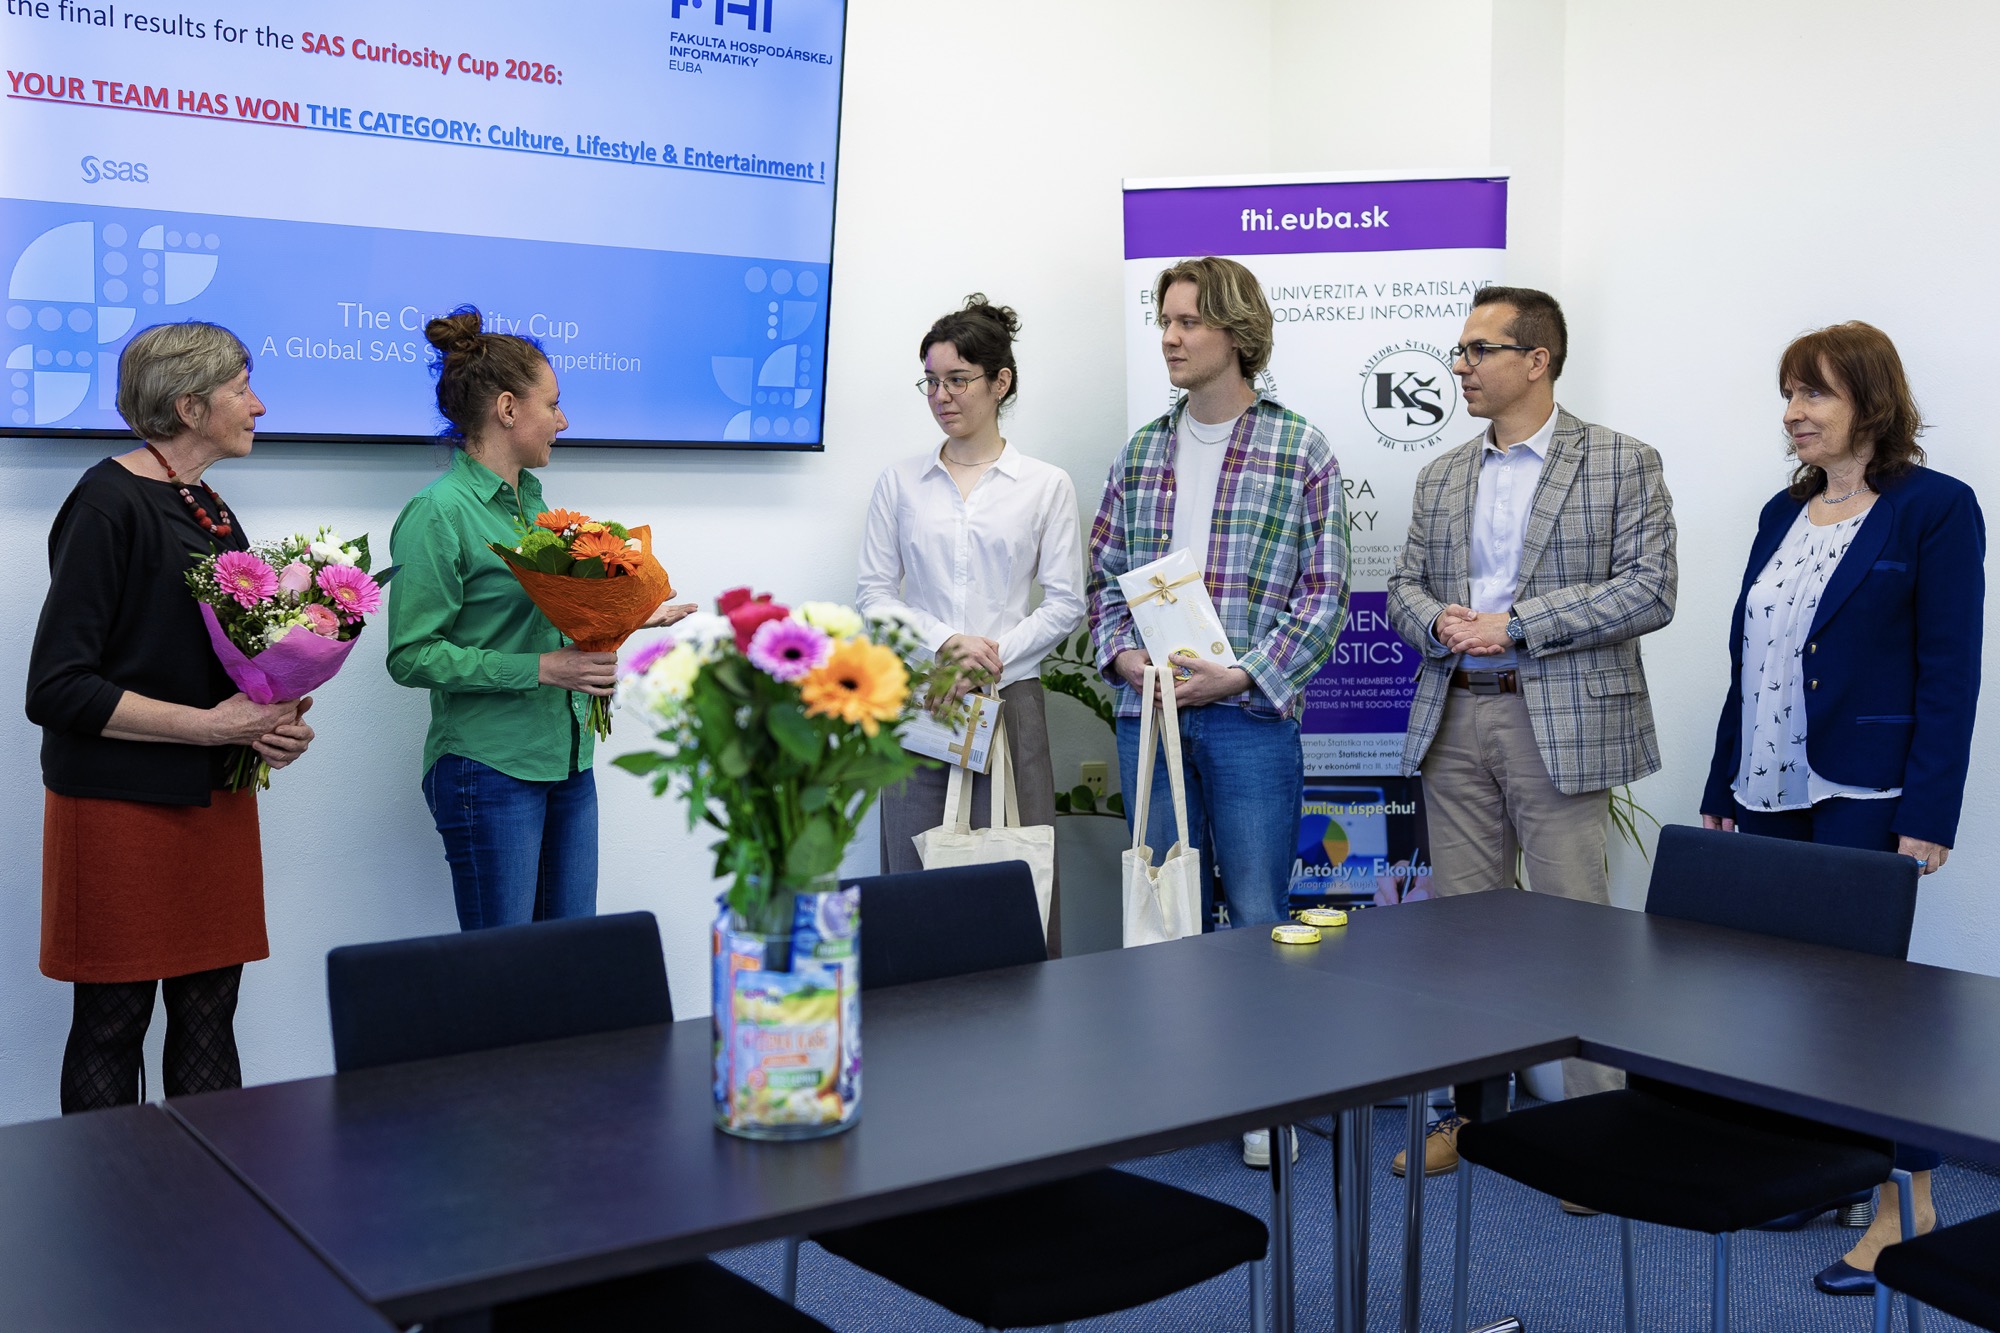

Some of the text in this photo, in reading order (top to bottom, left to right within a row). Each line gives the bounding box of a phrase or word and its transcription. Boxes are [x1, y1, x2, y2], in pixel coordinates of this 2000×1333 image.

[8, 0, 563, 85] the final results for the SAS Curiosity Cup 2026:
[670, 32, 833, 65] FAKULTA HOSPODÁRSKEJ
[669, 46, 759, 68] INFORMATIKY
[669, 60, 703, 74] EUBA
[7, 70, 85, 100] YOUR
[92, 79, 169, 109] TEAM
[177, 89, 228, 115] HAS
[235, 96, 299, 123] WON
[306, 104, 351, 128] THE
[358, 110, 482, 143] CATEGORY:
[487, 125, 570, 156] Culture,
[576, 134, 657, 164] Lifestyle
[662, 144, 678, 164] &
[684, 147, 814, 178] Entertainment
[1241, 205, 1390, 232] fhi.euba.sk
[1271, 284, 1368, 300] UNIVERZITA
[1374, 284, 1386, 297] V
[337, 302, 391, 329] The
[528, 313, 580, 343] Cup
[1273, 304, 1365, 323] ODÁRSKEJ
[260, 336, 278, 357] A
[285, 337, 362, 361] Global
[369, 340, 417, 363] SAS
[548, 350, 641, 374] mpetition
[1359, 343, 1401, 378] KATEDRA
[1372, 371, 1444, 426] KŠ
[1377, 436, 1396, 450] FHI
[1352, 545, 1392, 554] COVISKO,
[1332, 642, 1403, 664] ISTICS
[1341, 677, 1355, 686] THE
[1356, 676, 1393, 686] MEMBERS
[1395, 676, 1407, 685] OF
[1330, 689, 1342, 697] OF
[1343, 689, 1350, 697] A
[1351, 688, 1378, 697] LARGE
[1380, 688, 1401, 697] AREA
[1402, 688, 1415, 697] OF
[1306, 700, 1412, 710] SYSTEMS IN THE SOCIO-ECO
[1338, 749, 1378, 759] Štatistické
[1301, 800, 1416, 818] ovnicu úspechu!
[1357, 865, 1368, 877] v
